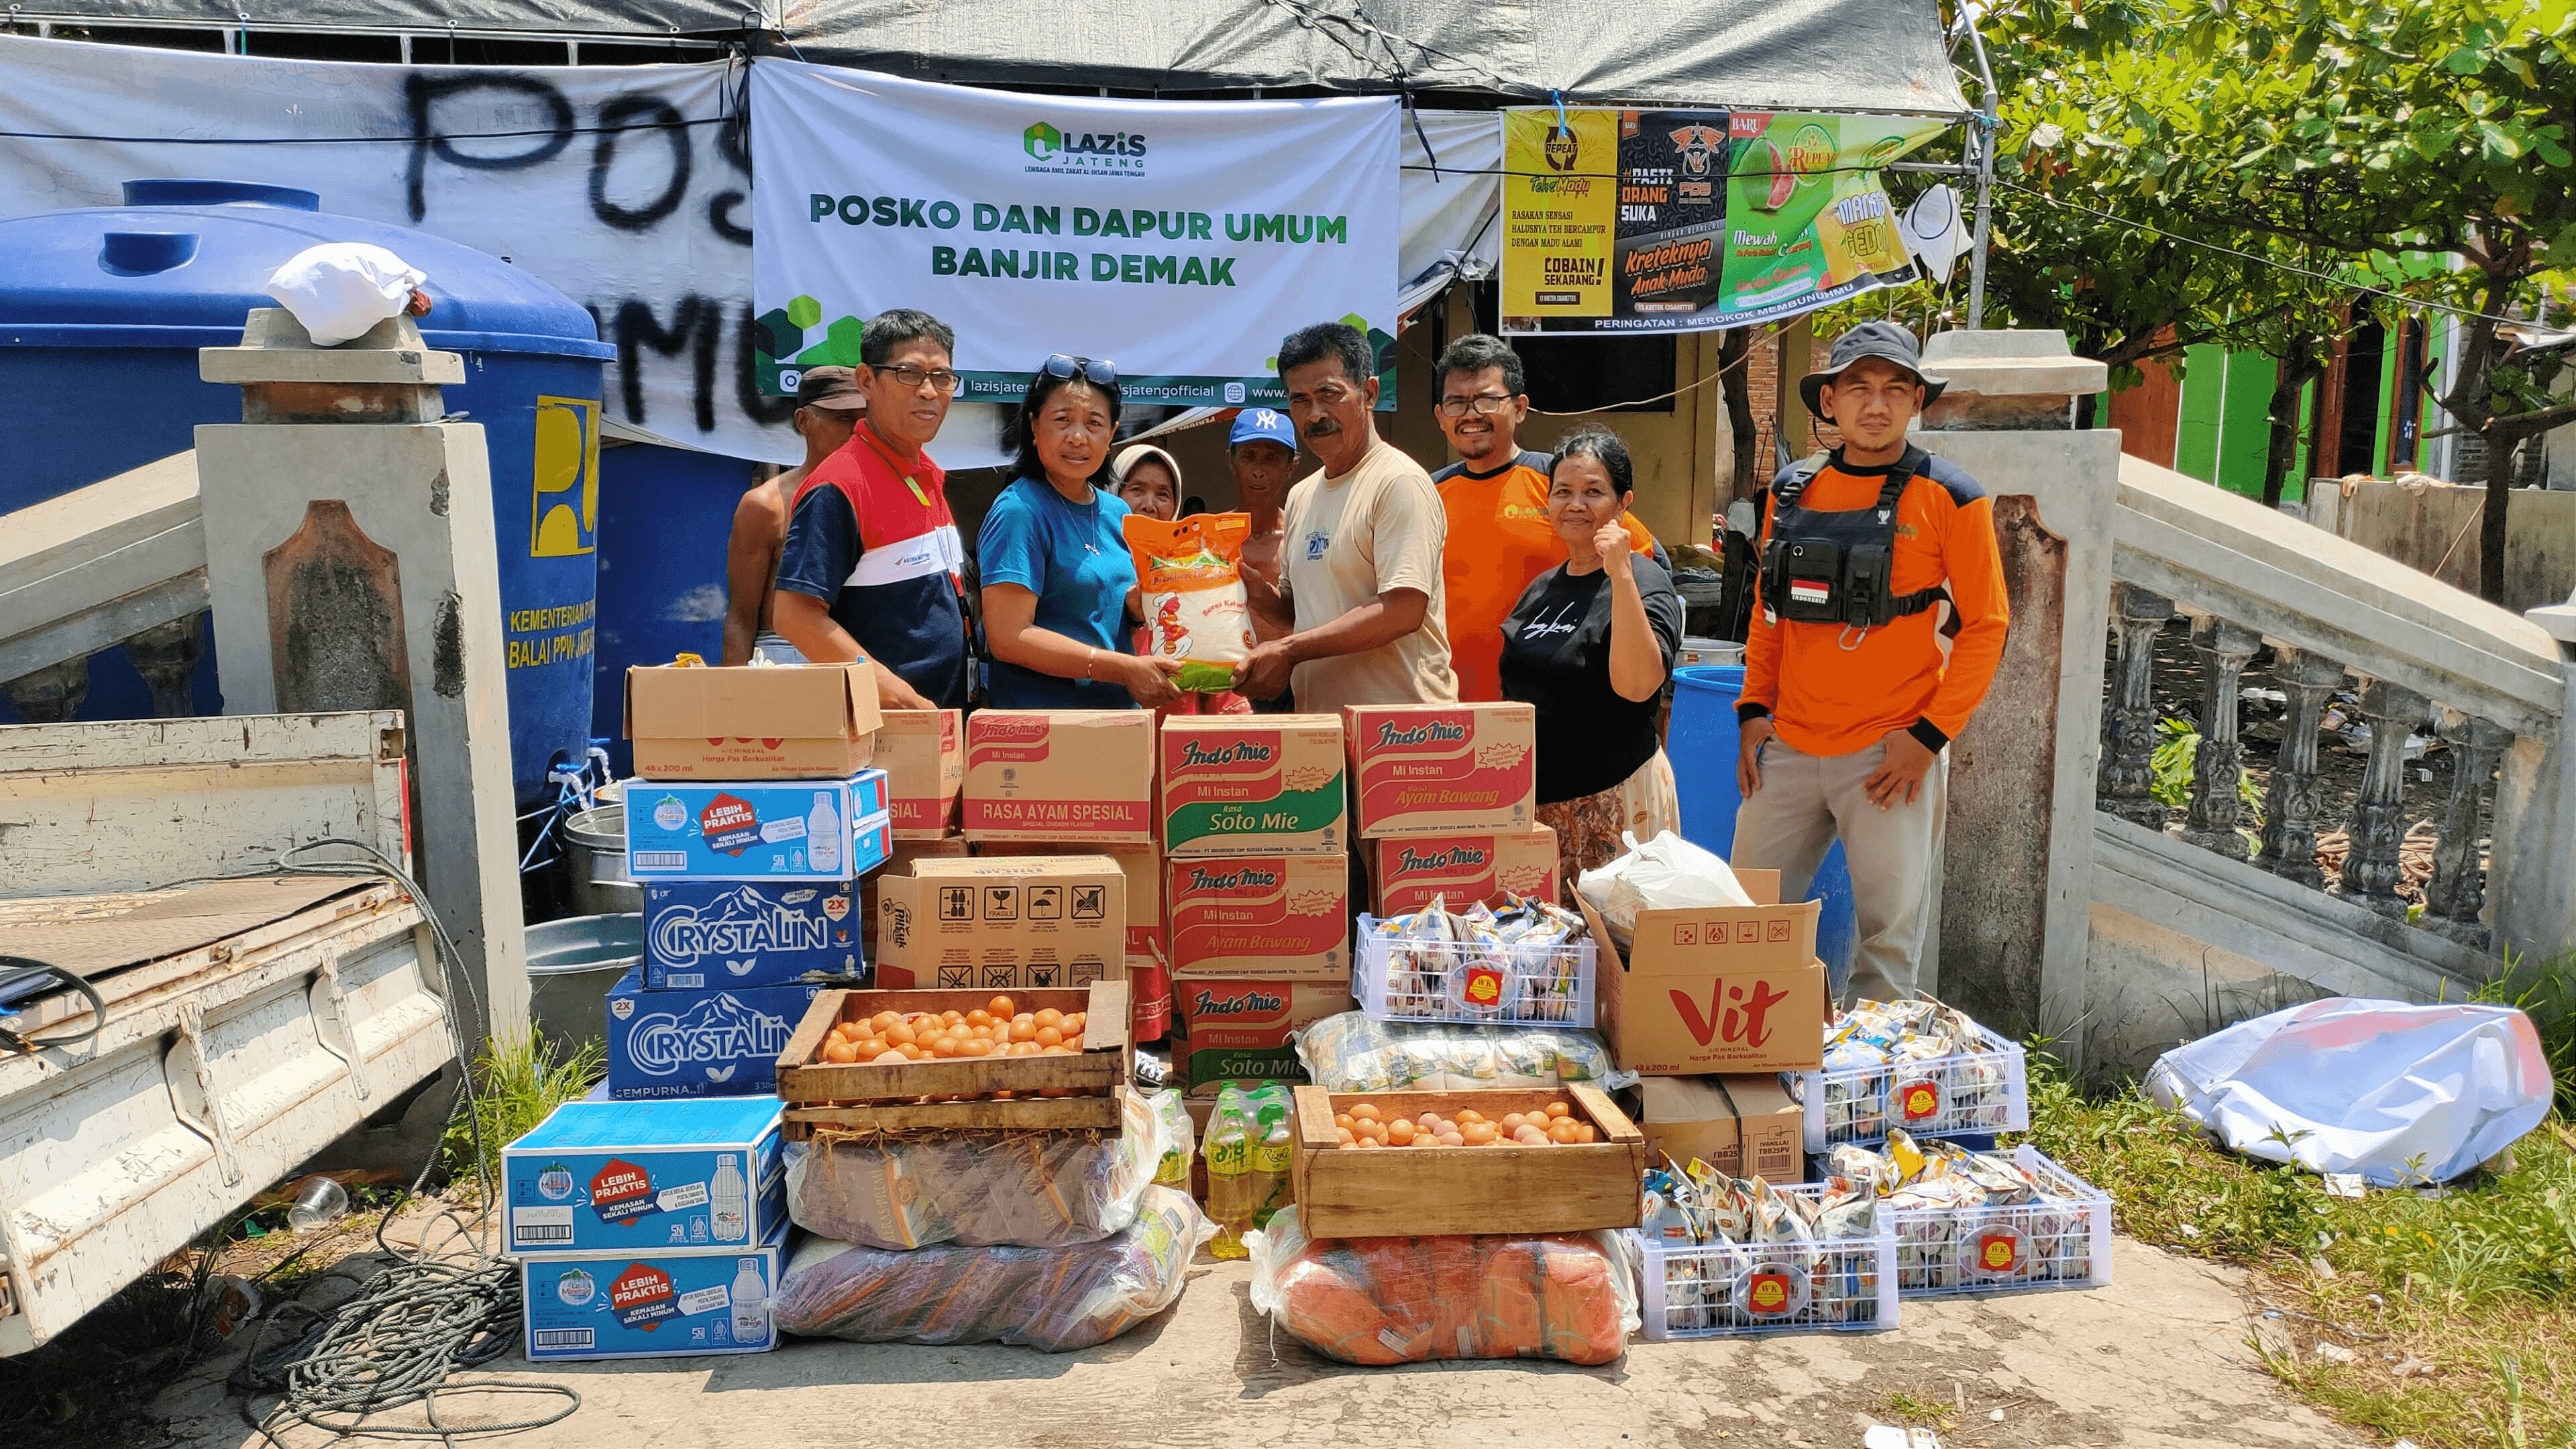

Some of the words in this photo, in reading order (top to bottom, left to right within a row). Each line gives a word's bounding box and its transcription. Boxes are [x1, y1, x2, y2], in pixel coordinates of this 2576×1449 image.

[1625, 121, 1635, 129] BARU
[1731, 117, 1760, 133] BARU
[1546, 143, 1578, 154] REPEAT
[1024, 166, 1051, 174] LEMBAGA
[1063, 156, 1144, 168] JATENG
[1622, 168, 1674, 185] #PASTI
[1621, 186, 1668, 203] ORANG
[810, 193, 961, 230] POSKO
[973, 203, 1061, 235] DAN
[1073, 207, 1213, 241] DAPUR
[1224, 213, 1347, 244] UMUM
[1512, 211, 1544, 220] RASAKAN
[1545, 211, 1573, 220] SENSASI
[1621, 205, 1657, 221] SUKA
[1511, 225, 1547, 233] HALUSNYA
[1548, 225, 1562, 234] TEH
[1564, 225, 1606, 234] BERCAMPUR
[1733, 229, 1778, 246] Mewah
[1511, 238, 1539, 247] DENGAN
[1540, 238, 1560, 248] MADU
[1562, 238, 1582, 248] ALAMI
[1544, 257, 1595, 273] COBAIN
[1624, 238, 1712, 276] Kreteknya
[932, 246, 1079, 281] BANJIR
[1091, 253, 1236, 286] DEMAK
[1630, 271, 1668, 297] Anak
[1668, 264, 1707, 288] Muda
[1595, 319, 1676, 329] PERINGATAN
[1686, 309, 1755, 326] MEROKOK
[1758, 283, 1854, 316] MEMBUNUHMU
[1792, 594, 1826, 604] INDONESIA
[510, 602, 584, 633] KEMENTERIAN
[508, 638, 550, 669] BALAI
[553, 633, 575, 663] PPW
[1366, 719, 1464, 753] Indomie
[991, 751, 1001, 759] Mi
[1002, 751, 1026, 759] Instan
[1171, 740, 1271, 773] Indomie
[645, 764, 657, 772] 48
[663, 764, 680, 772] 200
[682, 763, 693, 771] ml
[1393, 765, 1407, 775] Mi
[1408, 765, 1443, 775] Instan
[1197, 786, 1212, 796] Mi
[1214, 786, 1249, 797] Instan
[1395, 790, 1437, 808] Ayam
[1438, 790, 1499, 806] Bawang
[709, 803, 743, 818] LEBIH
[983, 804, 1023, 820] RASA
[1026, 804, 1069, 820] AYAM
[1073, 804, 1134, 821] SPESIAL
[1222, 805, 1242, 813] Rasa
[704, 812, 753, 830] PRAKTIS
[1209, 813, 1256, 830] Soto
[1260, 812, 1299, 830] Mie
[717, 831, 750, 842] KEMASAN
[1387, 846, 1483, 880] Indomie
[1179, 867, 1276, 898] Indomie
[1414, 890, 1428, 900] Mi
[827, 900, 847, 910] 2X
[1203, 910, 1218, 920] Mi
[1219, 910, 1254, 920] Instan
[648, 904, 828, 968] CRYSTALIN
[1206, 935, 1248, 953] Ayam
[1250, 935, 1311, 951] Bawang
[615, 1001, 631, 1010] 2X
[1191, 989, 1282, 1018] Indomie
[1669, 977, 1789, 1049] Vit
[1208, 1034, 1222, 1044] Mi
[1224, 1034, 1259, 1044] Instan
[1689, 1053, 1711, 1062] Harga
[1727, 1052, 1767, 1061] Berkualitas
[1220, 1059, 1266, 1076] Soto
[1271, 1059, 1303, 1075] Mie
[600, 1172, 637, 1188] LEBIH
[594, 1179, 647, 1199] PRAKTIS
[602, 1208, 629, 1220] SEKALI
[629, 1203, 655, 1215] MINUM
[608, 1198, 645, 1212] KEMASAN
[1991, 1245, 2006, 1254] WK
[621, 1274, 659, 1292] LEBIH
[1761, 1285, 1778, 1293] WK
[614, 1283, 669, 1304] PRAKTIS
[623, 1313, 650, 1324] SEKALI
[650, 1307, 676, 1318] MINUM
[629, 1303, 666, 1316] KEMASAN
